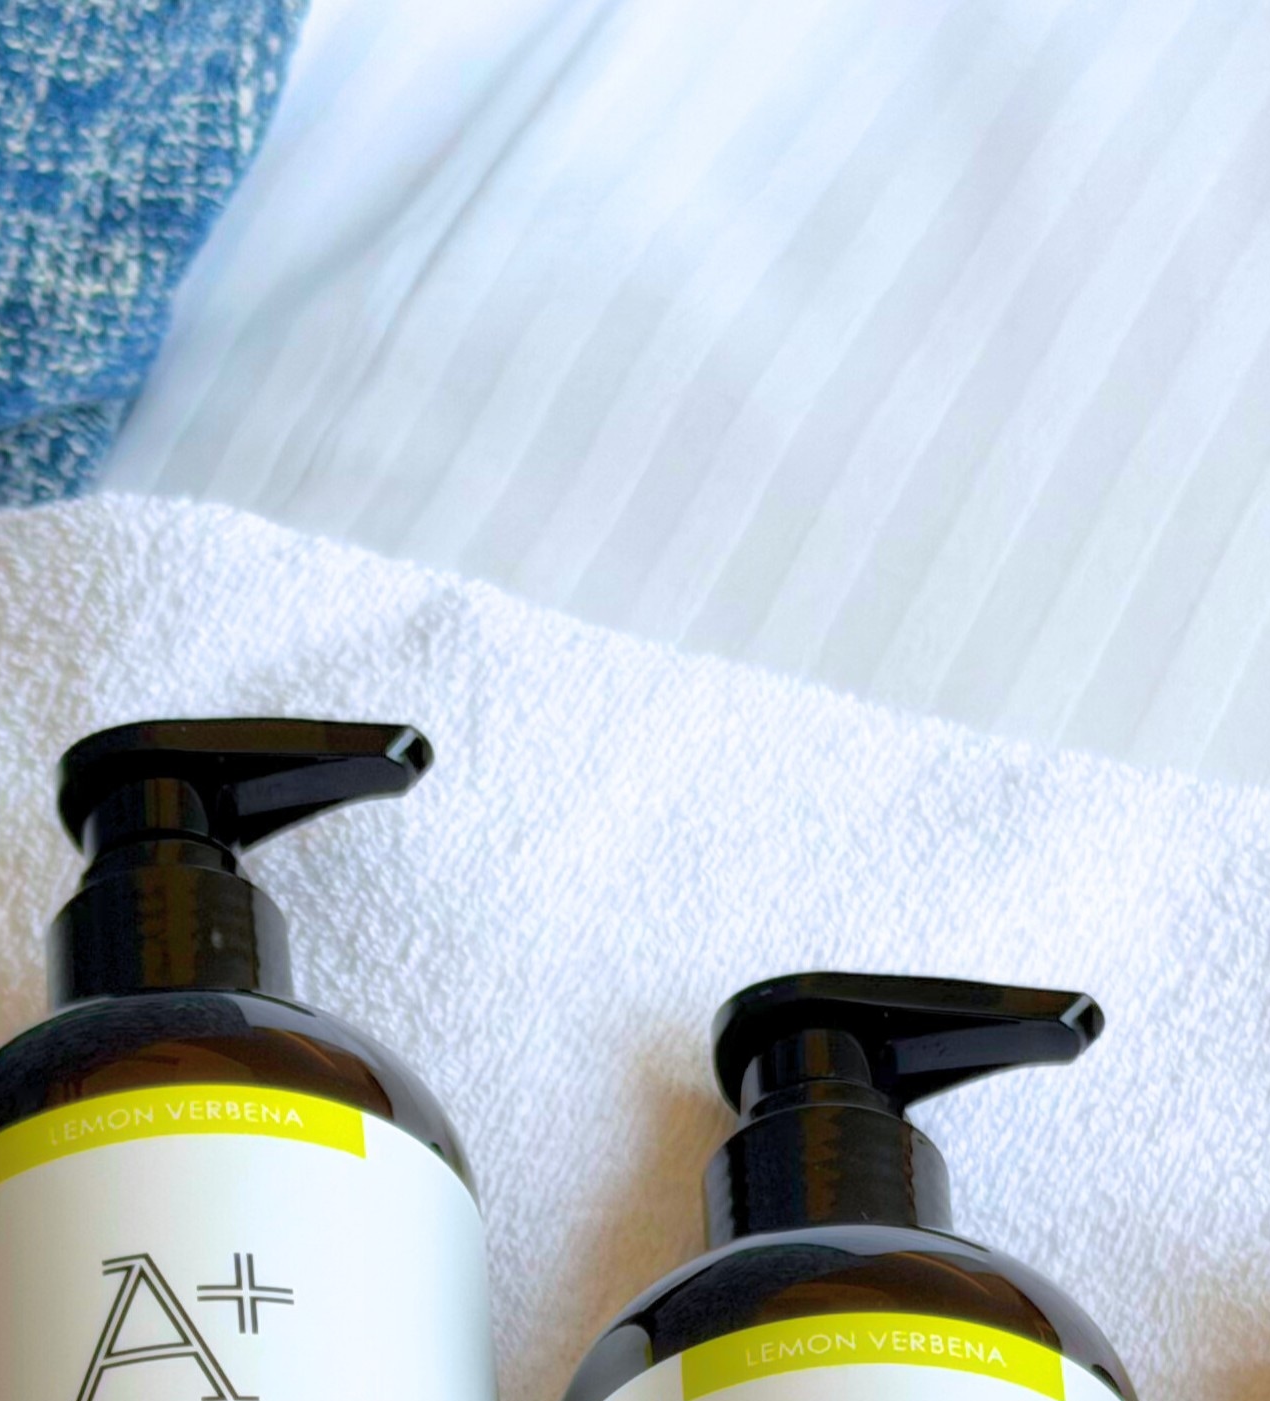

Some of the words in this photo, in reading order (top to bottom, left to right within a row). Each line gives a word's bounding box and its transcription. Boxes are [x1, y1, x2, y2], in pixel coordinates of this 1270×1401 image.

[52, 1107, 154, 1144] LEMON
[166, 1100, 304, 1128] VERBENA
[748, 1333, 856, 1366] LEMON
[869, 1331, 1007, 1367] VERBENA
